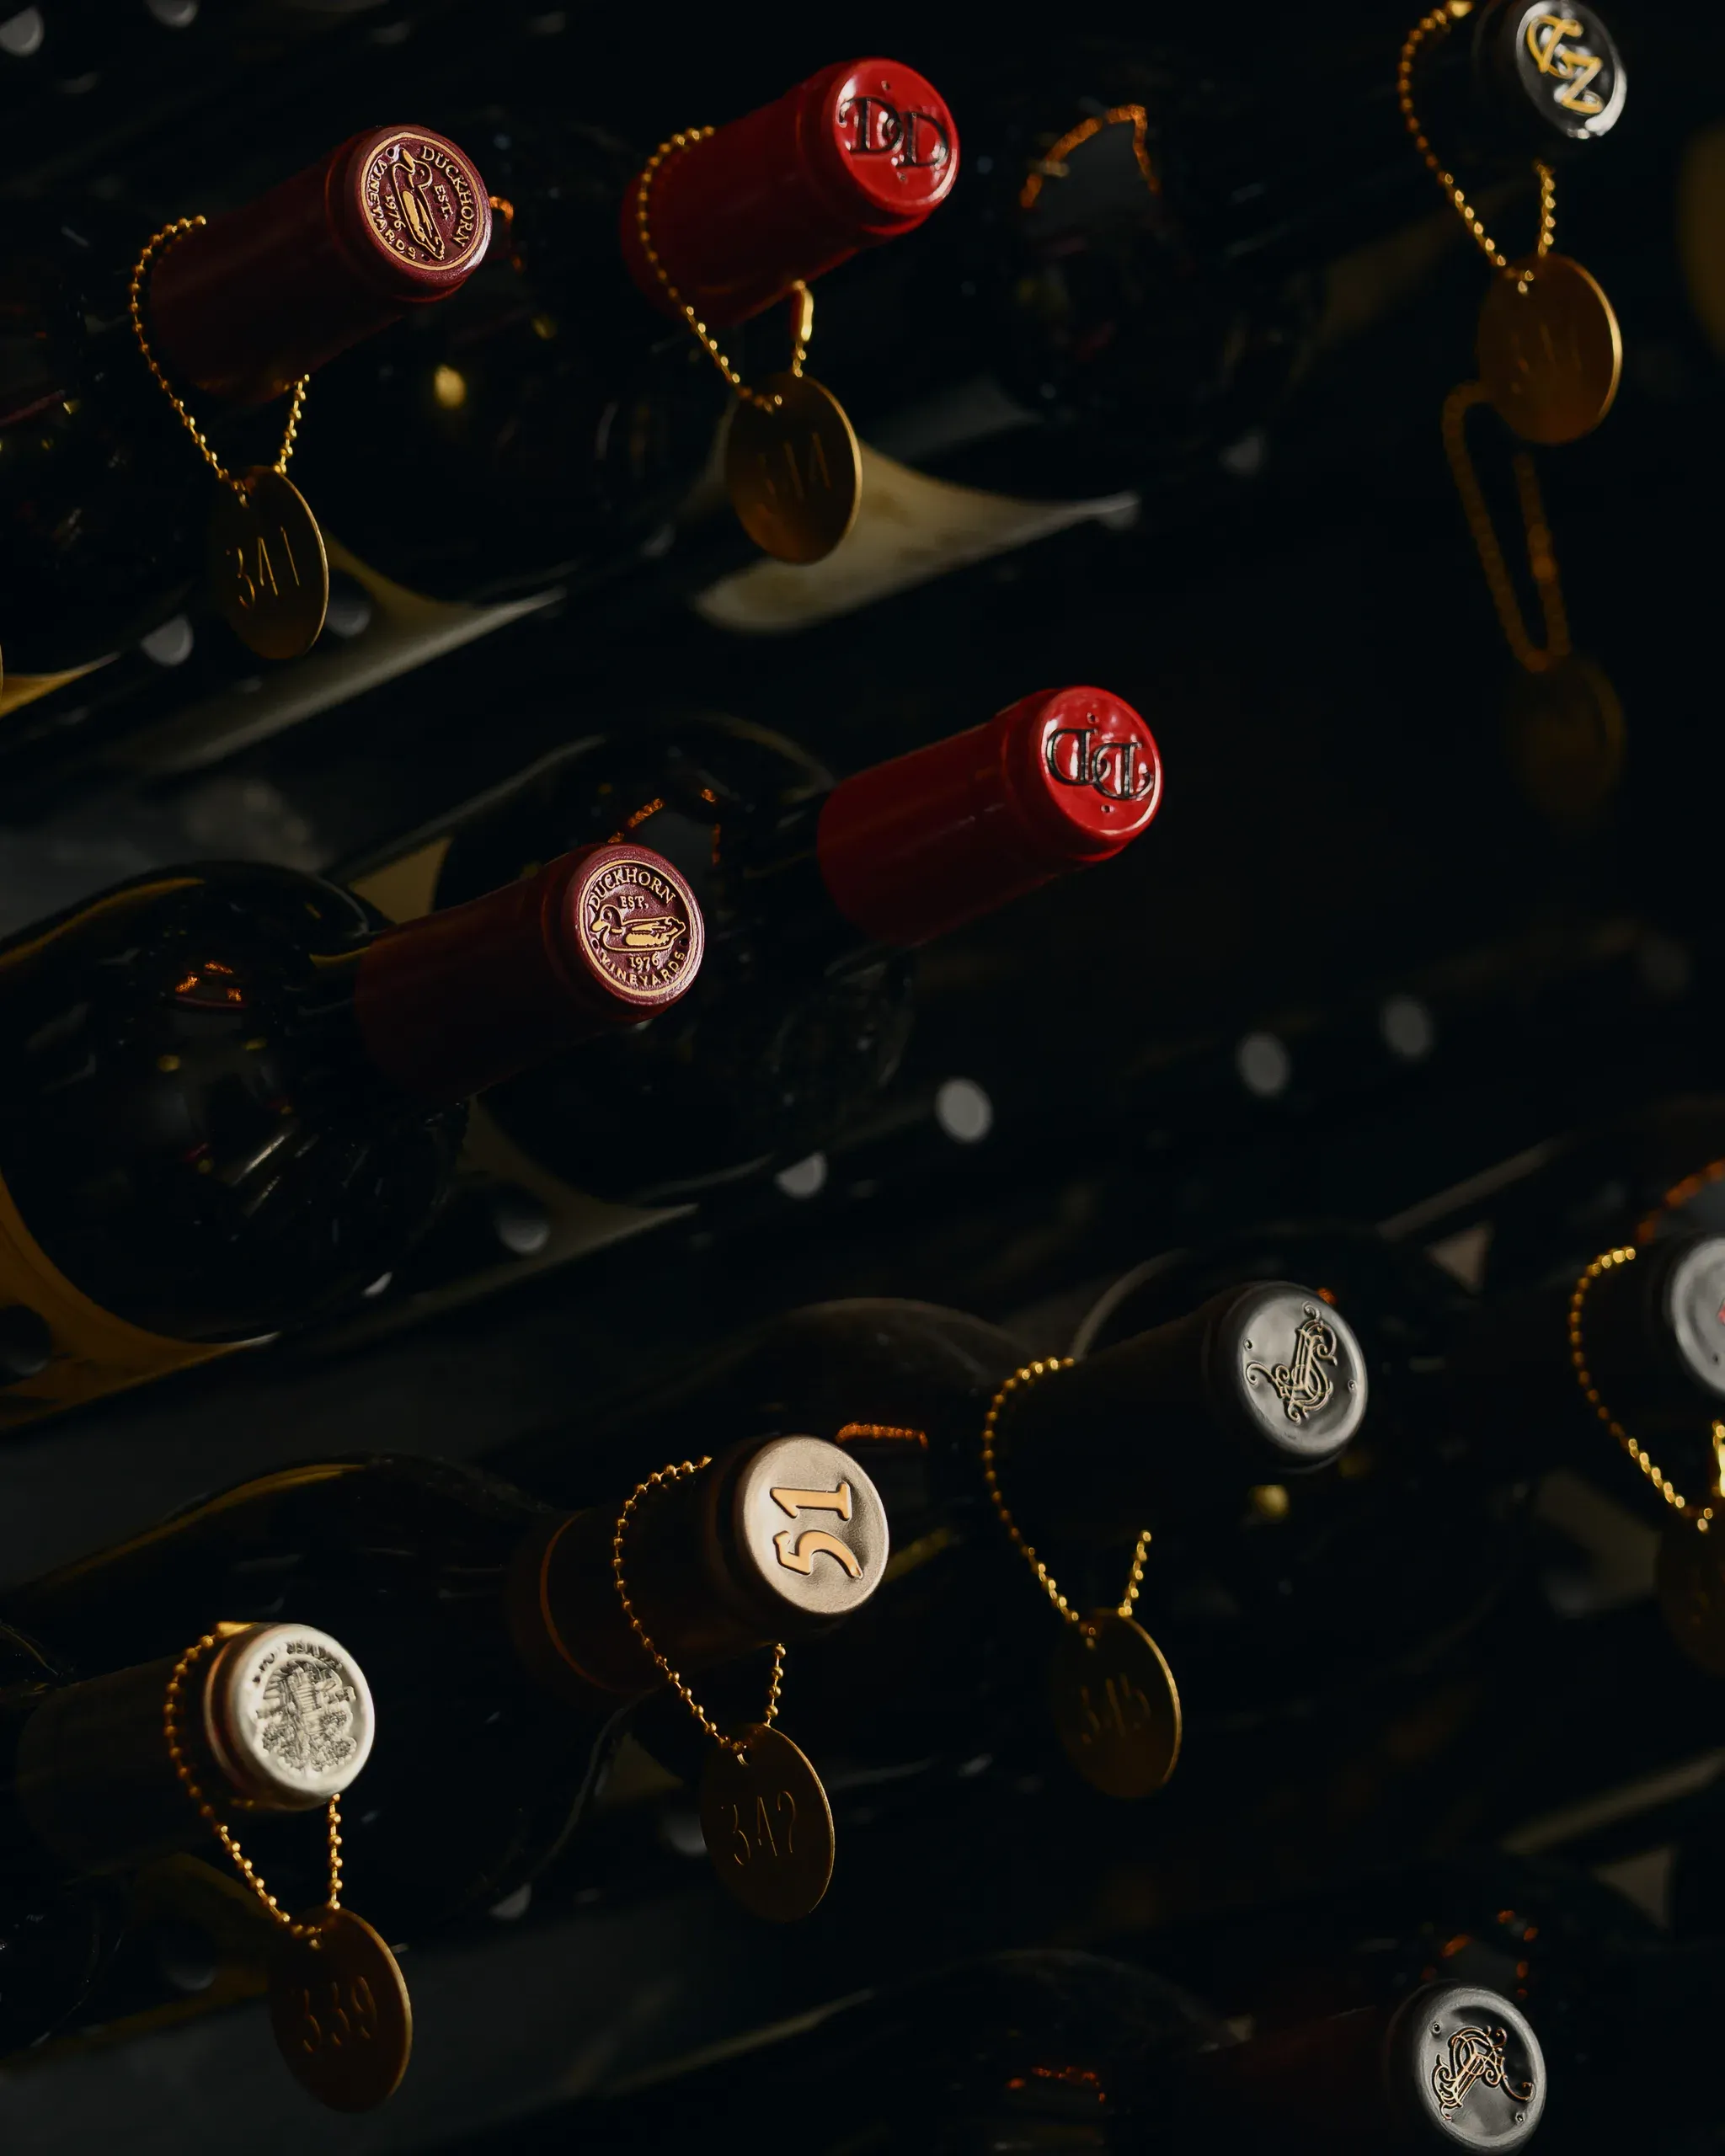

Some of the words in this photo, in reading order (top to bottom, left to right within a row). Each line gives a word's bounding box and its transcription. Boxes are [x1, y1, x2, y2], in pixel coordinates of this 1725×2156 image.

[838, 96, 949, 168] DD
[367, 158, 417, 259] VINEYARDS
[384, 194, 406, 232] 1976
[421, 145, 474, 248] DUCKHORN
[223, 523, 303, 611] 341
[1045, 728, 1154, 801] DD
[588, 867, 676, 911] DUCKHORN
[600, 950, 687, 986] VINEYARDS
[629, 953, 660, 971] 1976
[769, 1480, 864, 1580] 51
